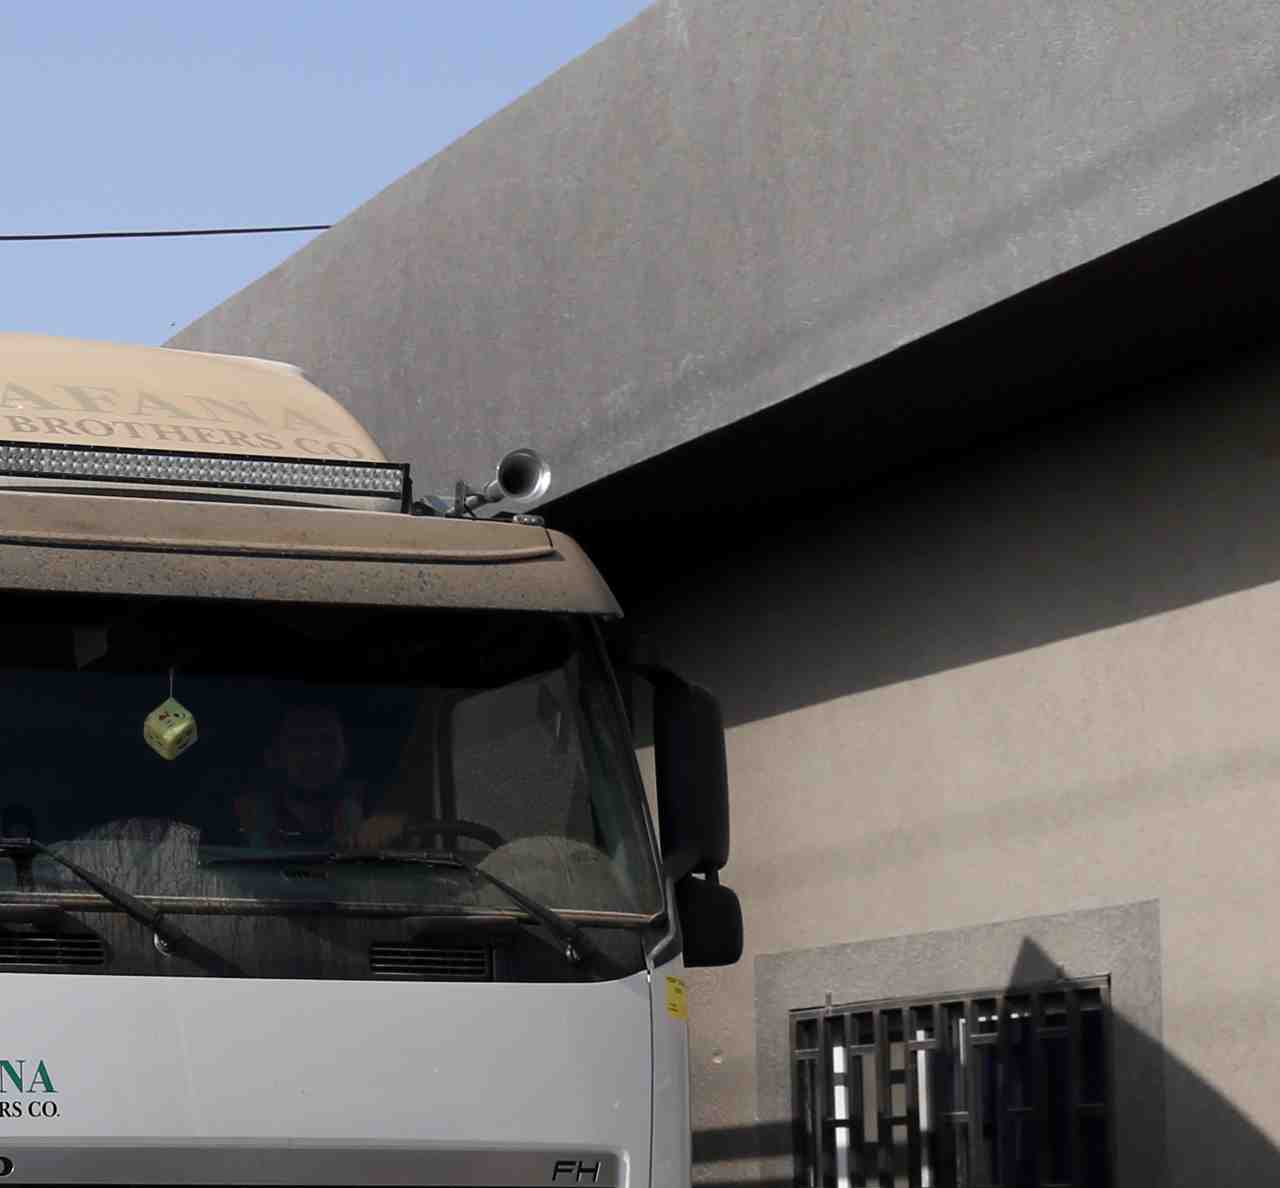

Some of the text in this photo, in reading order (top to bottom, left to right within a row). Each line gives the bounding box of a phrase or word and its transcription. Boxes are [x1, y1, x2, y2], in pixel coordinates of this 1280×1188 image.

[4, 415, 283, 450] BROTHERS
[28, 1100, 60, 1118] CO.
[552, 1160, 601, 1183] FH
